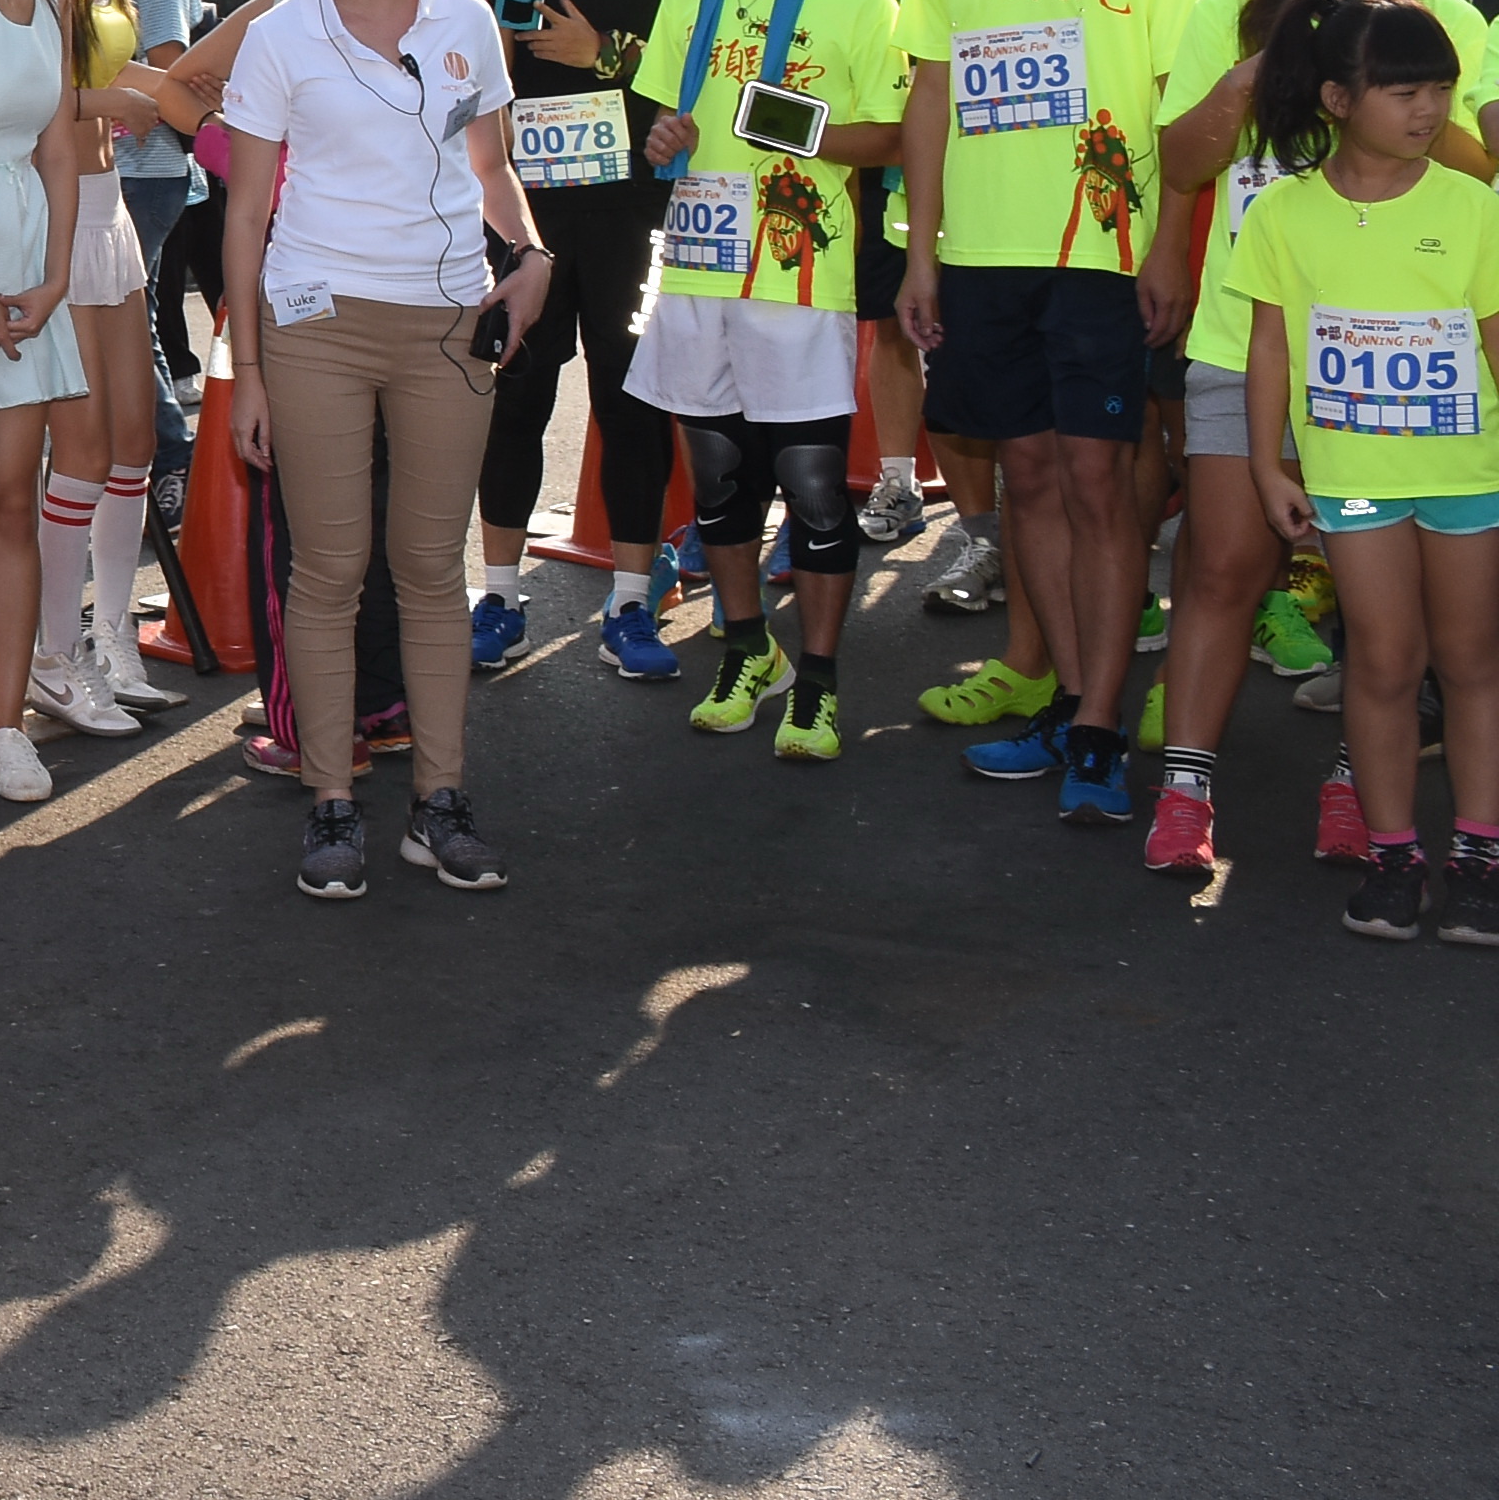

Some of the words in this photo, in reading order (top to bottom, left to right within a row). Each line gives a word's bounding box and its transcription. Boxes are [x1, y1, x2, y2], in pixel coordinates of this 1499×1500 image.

[983, 43, 1026, 59] RUNNING
[1029, 42, 1049, 52] FUN
[964, 54, 1070, 97] 0193
[521, 120, 616, 155] 0078
[667, 201, 738, 235] 0002
[286, 294, 317, 308] Luke
[1352, 324, 1382, 332] FAMILY
[1447, 323, 1466, 331] 10K
[1344, 330, 1404, 347] RUNNING
[1409, 335, 1434, 347] FUN
[1319, 346, 1458, 391] 0105
